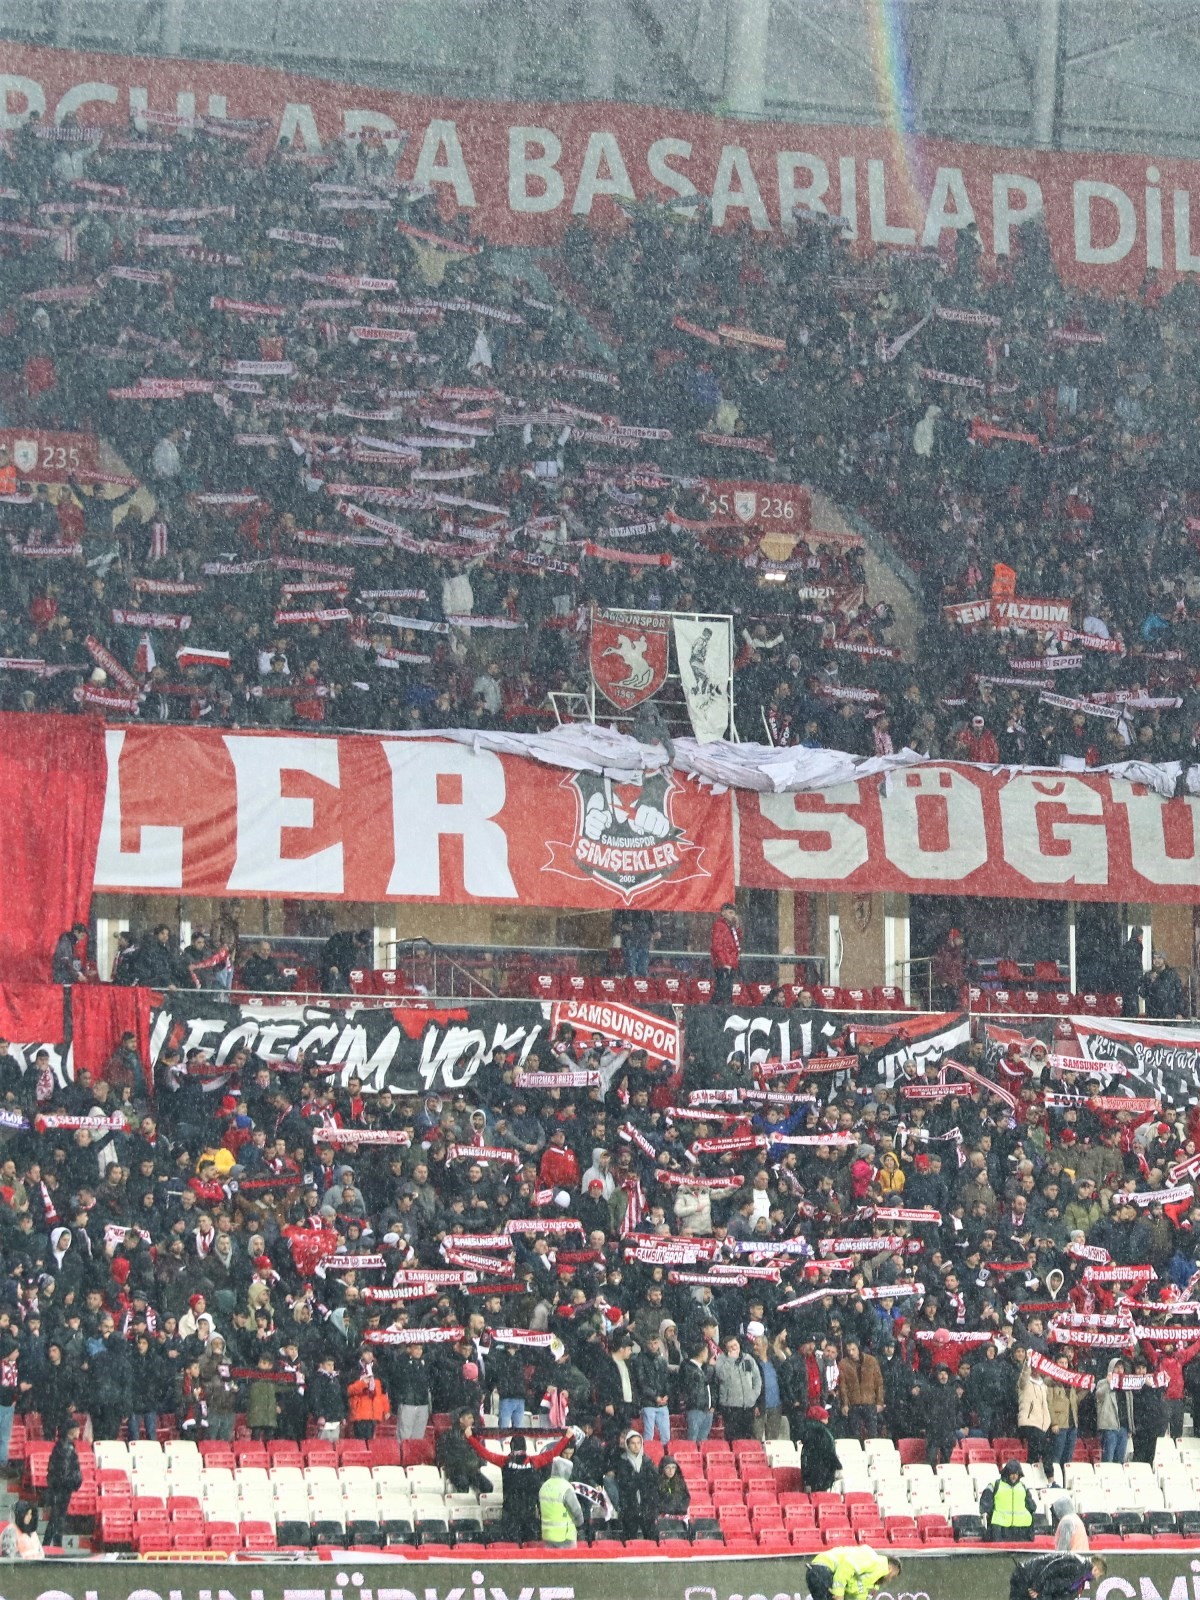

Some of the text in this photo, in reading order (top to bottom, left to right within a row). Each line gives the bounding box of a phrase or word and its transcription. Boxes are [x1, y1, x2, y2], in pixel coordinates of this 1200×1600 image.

[42, 446, 80, 469] 235
[760, 498, 794, 521] 236
[596, 607, 666, 629] SAMSUNSPOR
[997, 602, 1069, 622] YAZDIM
[833, 641, 893, 657] SAMSUNSPOR
[1053, 656, 1082, 668] SPOR
[601, 834, 656, 848] SAMSUNSPOR
[575, 838, 680, 872] ŞİMŞEKLER
[619, 874, 636, 884] 2002
[568, 1000, 677, 1054] SAMSUNSPOR
[457, 1148, 513, 1161] SAMSUNSPOR
[1130, 1190, 1191, 1205] Samsunspor
[516, 1219, 582, 1231] SAMSUNSPOR
[454, 1236, 510, 1247] SAMSUNSPOR
[742, 1242, 801, 1254] ORDUSPOR
[833, 1240, 891, 1251] SAMSUNSPOR
[408, 1272, 461, 1283] SAMSUNSPOR
[373, 1286, 424, 1299] SAMSUNSPOR
